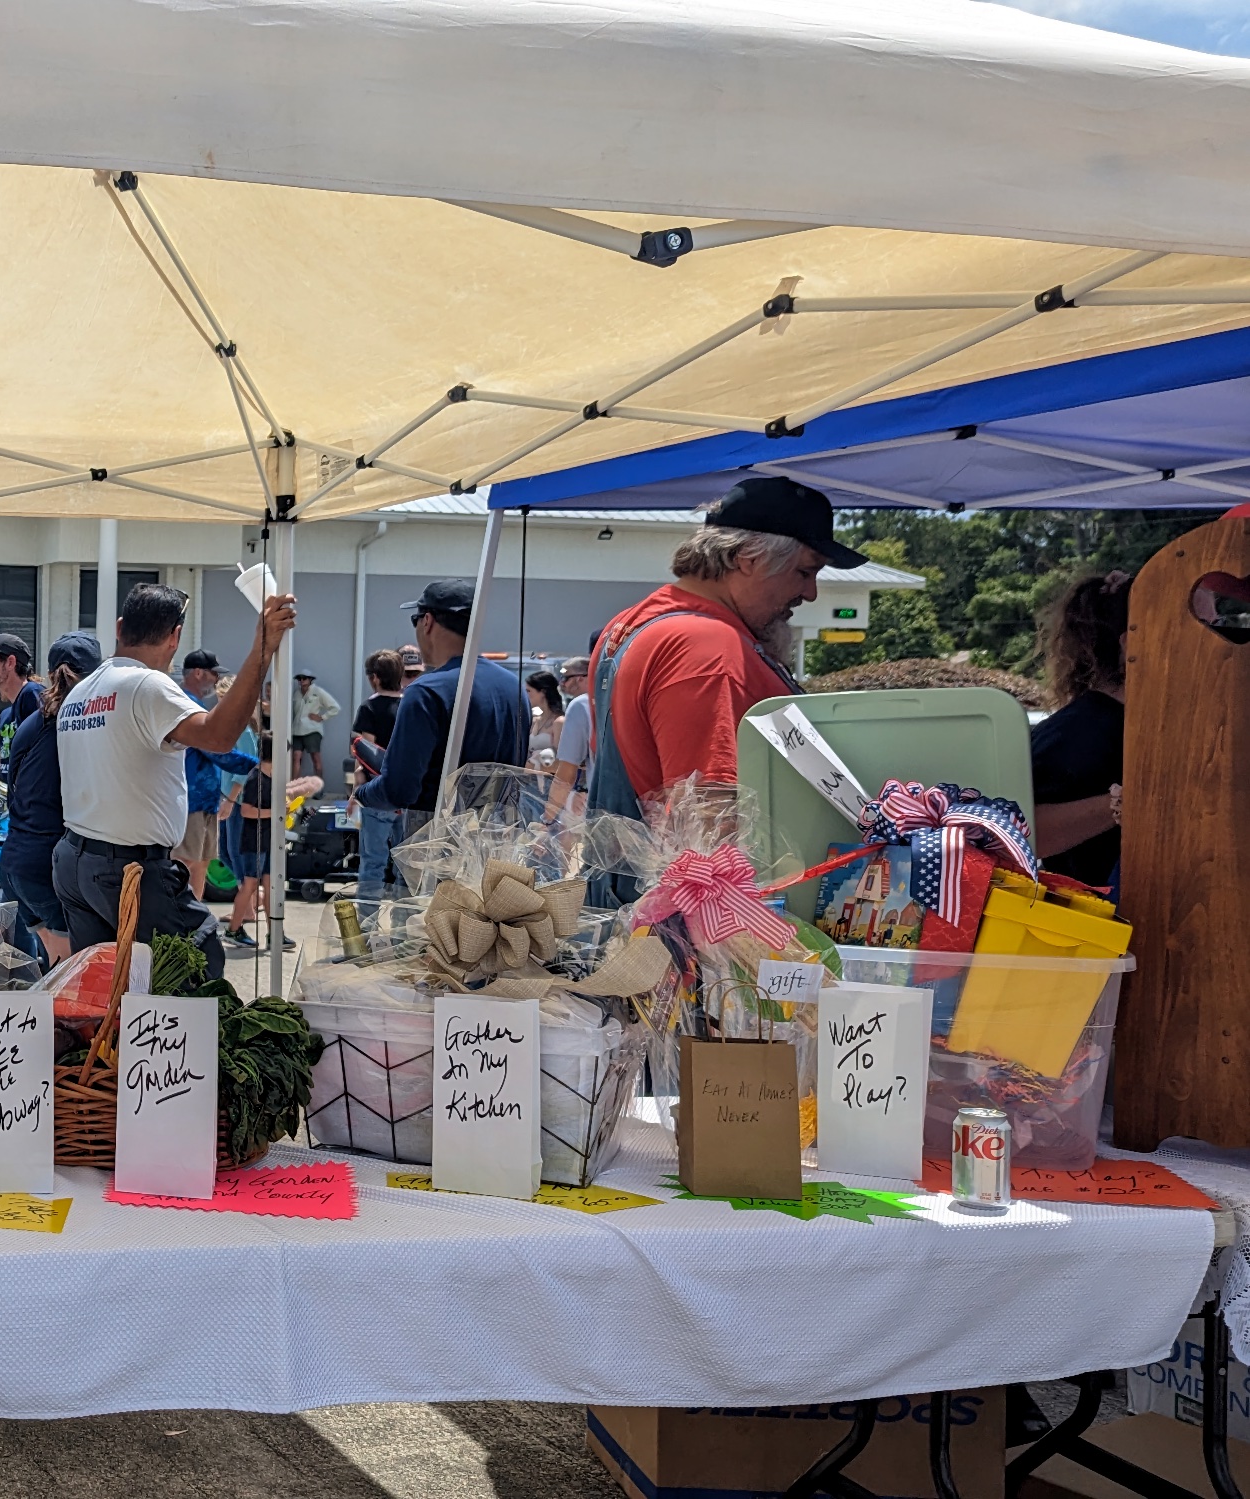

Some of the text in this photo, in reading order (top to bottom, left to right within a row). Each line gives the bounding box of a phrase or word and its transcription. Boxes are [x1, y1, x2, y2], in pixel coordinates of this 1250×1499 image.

[768, 968, 806, 996] gift
[18, 1006, 37, 1033] to
[127, 1009, 179, 1045] It's
[445, 1015, 524, 1051] Gather
[828, 1012, 887, 1047] Want
[837, 1039, 874, 1070] To
[445, 1089, 521, 1122] Kitchen
[842, 1073, 908, 1114] Play?
[972, 1123, 1001, 1134] Diet
